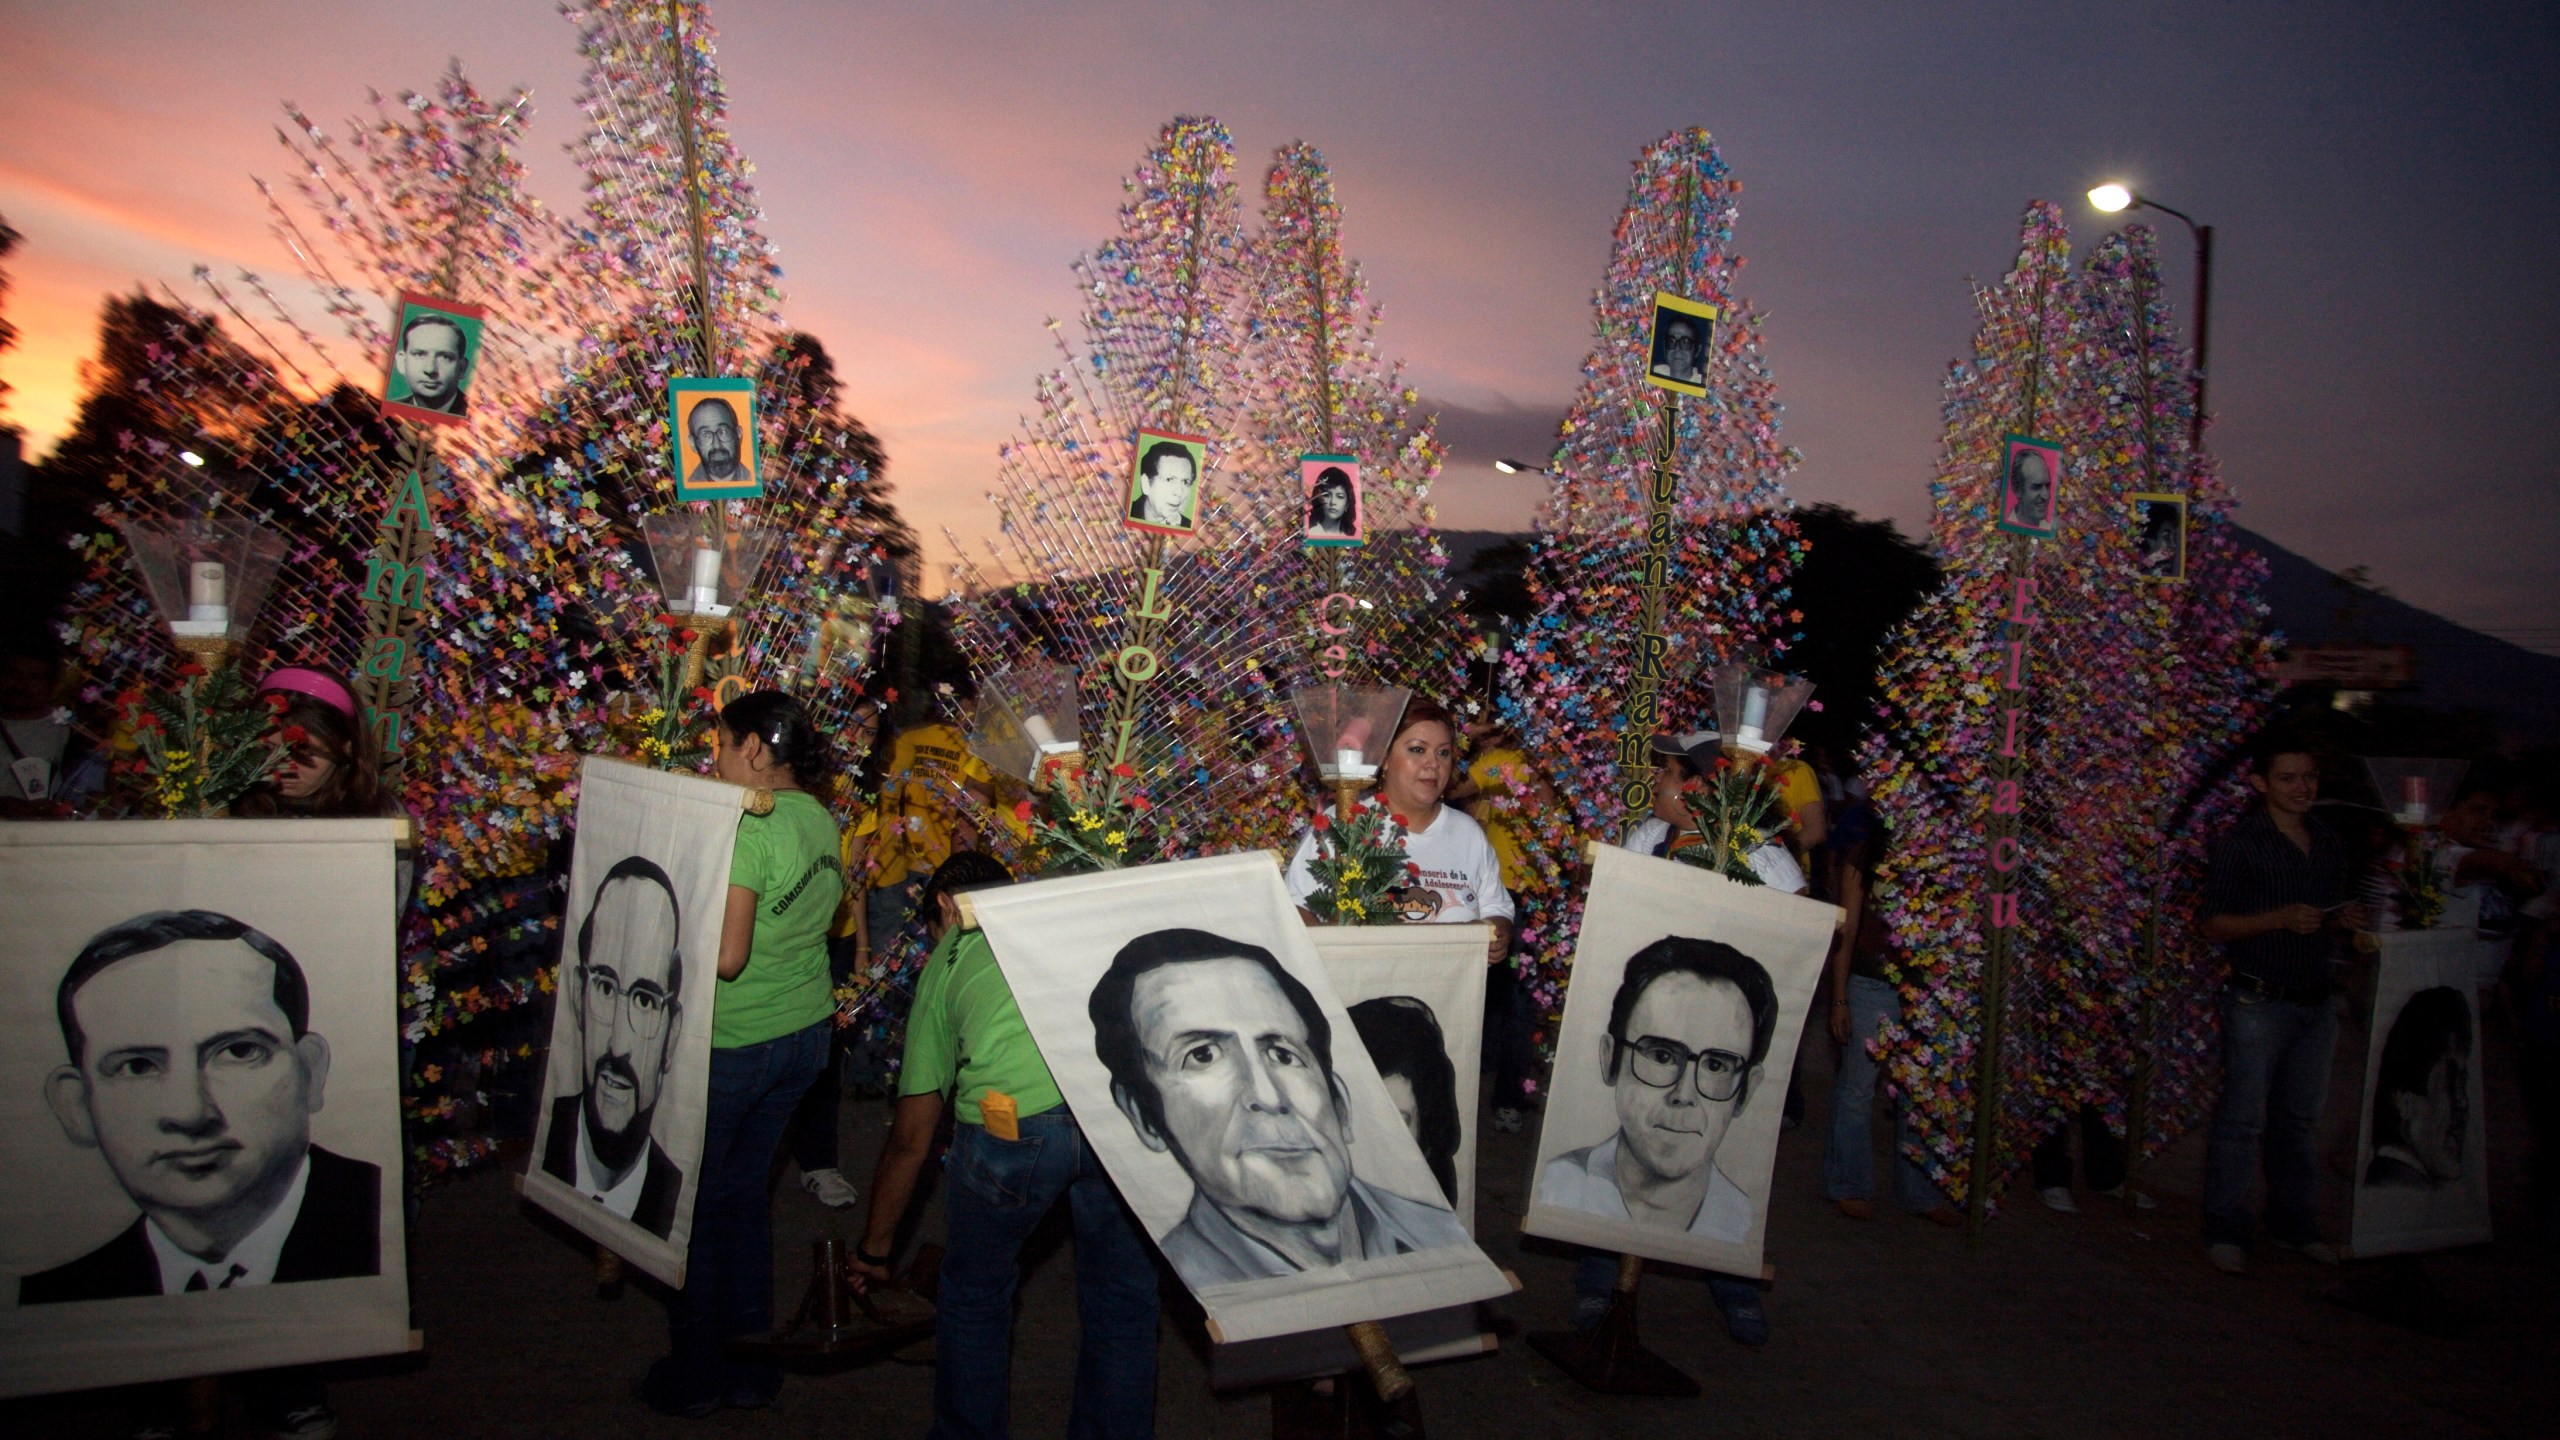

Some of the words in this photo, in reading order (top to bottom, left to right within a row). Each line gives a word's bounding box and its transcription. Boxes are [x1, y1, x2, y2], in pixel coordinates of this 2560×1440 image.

[1640, 406, 1681, 588] Juan
[1990, 577, 2039, 928] Ellacu
[771, 867, 812, 916] COMISION
[1449, 869, 1459, 880] de
[1459, 870, 1468, 881] la
